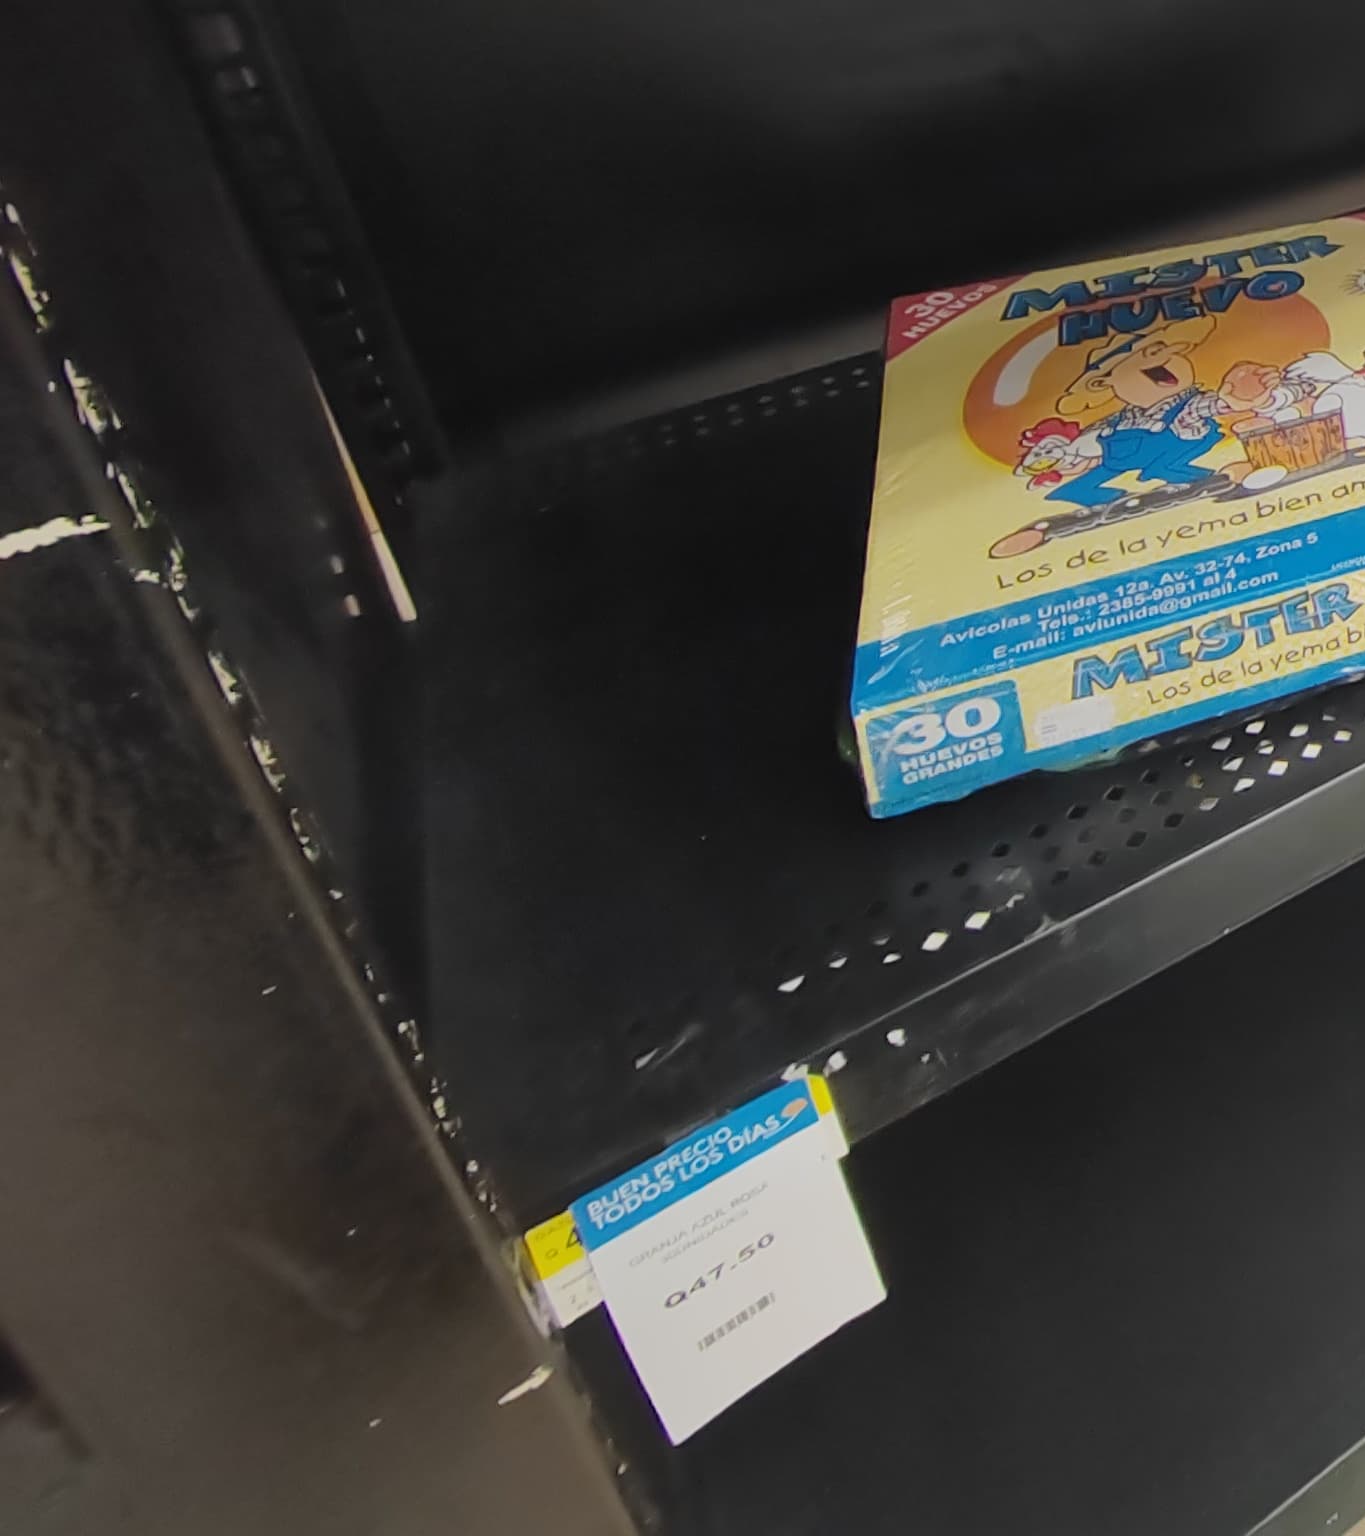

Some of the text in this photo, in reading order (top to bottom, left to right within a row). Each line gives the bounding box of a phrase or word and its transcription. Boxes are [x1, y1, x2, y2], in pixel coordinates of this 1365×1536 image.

[902, 281, 999, 341] HUEVOS
[904, 289, 956, 319] 30
[1000, 235, 1344, 321] MISTER
[1059, 270, 1305, 347] HUEVO
[995, 562, 1053, 591] Los
[1065, 545, 1109, 570] de
[1119, 529, 1148, 555] la
[1156, 510, 1249, 549] yema
[1256, 489, 1323, 519] bien
[1037, 589, 1108, 620] Unidas
[1159, 569, 1189, 587] Av.
[1255, 537, 1303, 560] Zona
[1306, 532, 1319, 546] 5
[1203, 570, 1222, 590] al
[1224, 567, 1238, 583] 4
[992, 629, 1067, 660] E-mail:
[1070, 582, 1363, 701] MISTER
[1147, 679, 1191, 706] Los
[1201, 664, 1233, 689] de
[1240, 653, 1264, 677] la
[1268, 633, 1341, 673] yema
[898, 696, 1002, 757] 30
[899, 731, 1003, 772] HUEVOS
[902, 745, 1004, 785] GRANDES
[586, 1125, 734, 1216] BUEN PRECIO
[591, 1175, 676, 1230] TODOS
[679, 1148, 725, 1181] LOS
[726, 1115, 782, 1154] DÍAS
[690, 1206, 727, 1234] AZUL
[663, 1232, 776, 1310] Q47.50
